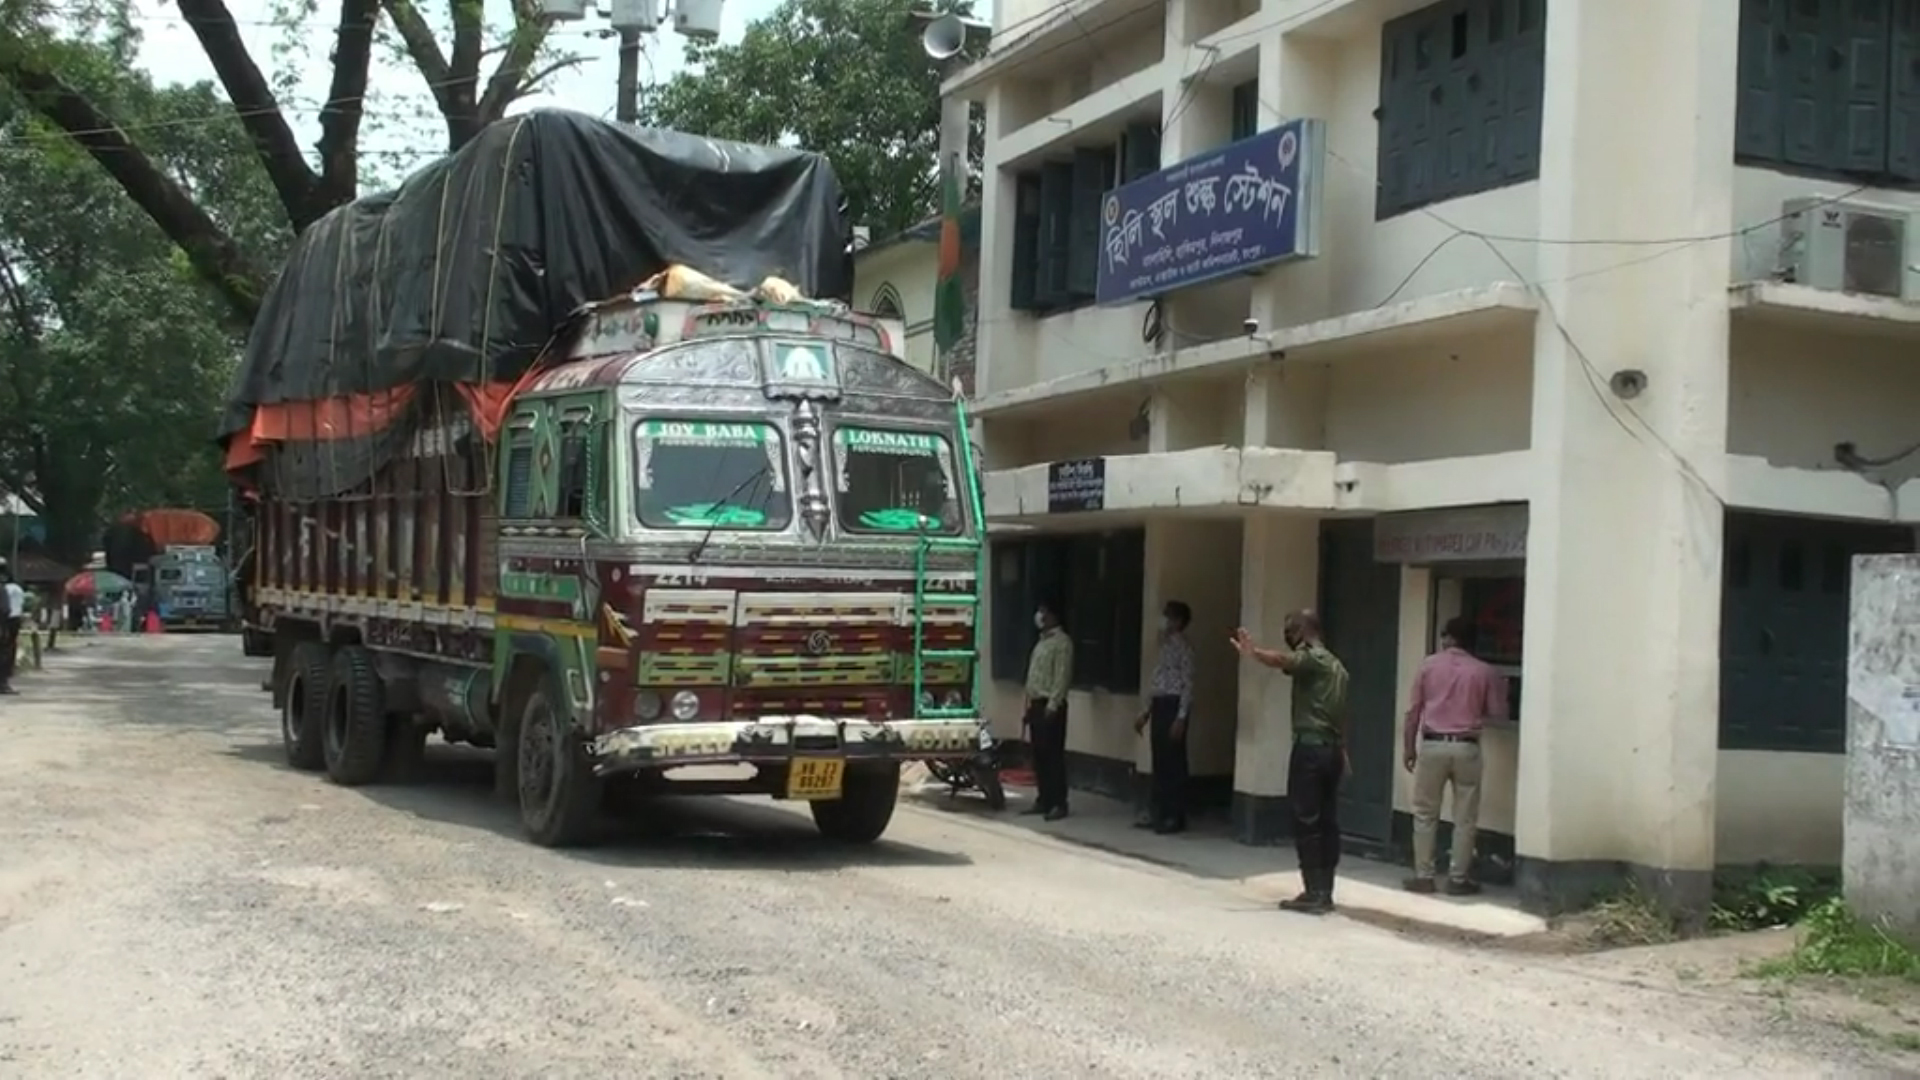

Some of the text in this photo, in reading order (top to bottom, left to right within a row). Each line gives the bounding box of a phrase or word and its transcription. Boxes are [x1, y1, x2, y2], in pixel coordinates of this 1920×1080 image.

[1106, 207, 1144, 274] হিলি
[1147, 188, 1181, 240] স্থল
[1184, 175, 1221, 217] শুল্ক
[1224, 160, 1292, 229] স্টেশন
[661, 422, 758, 440] JOY BABA
[848, 429, 931, 448] LOKNATH
